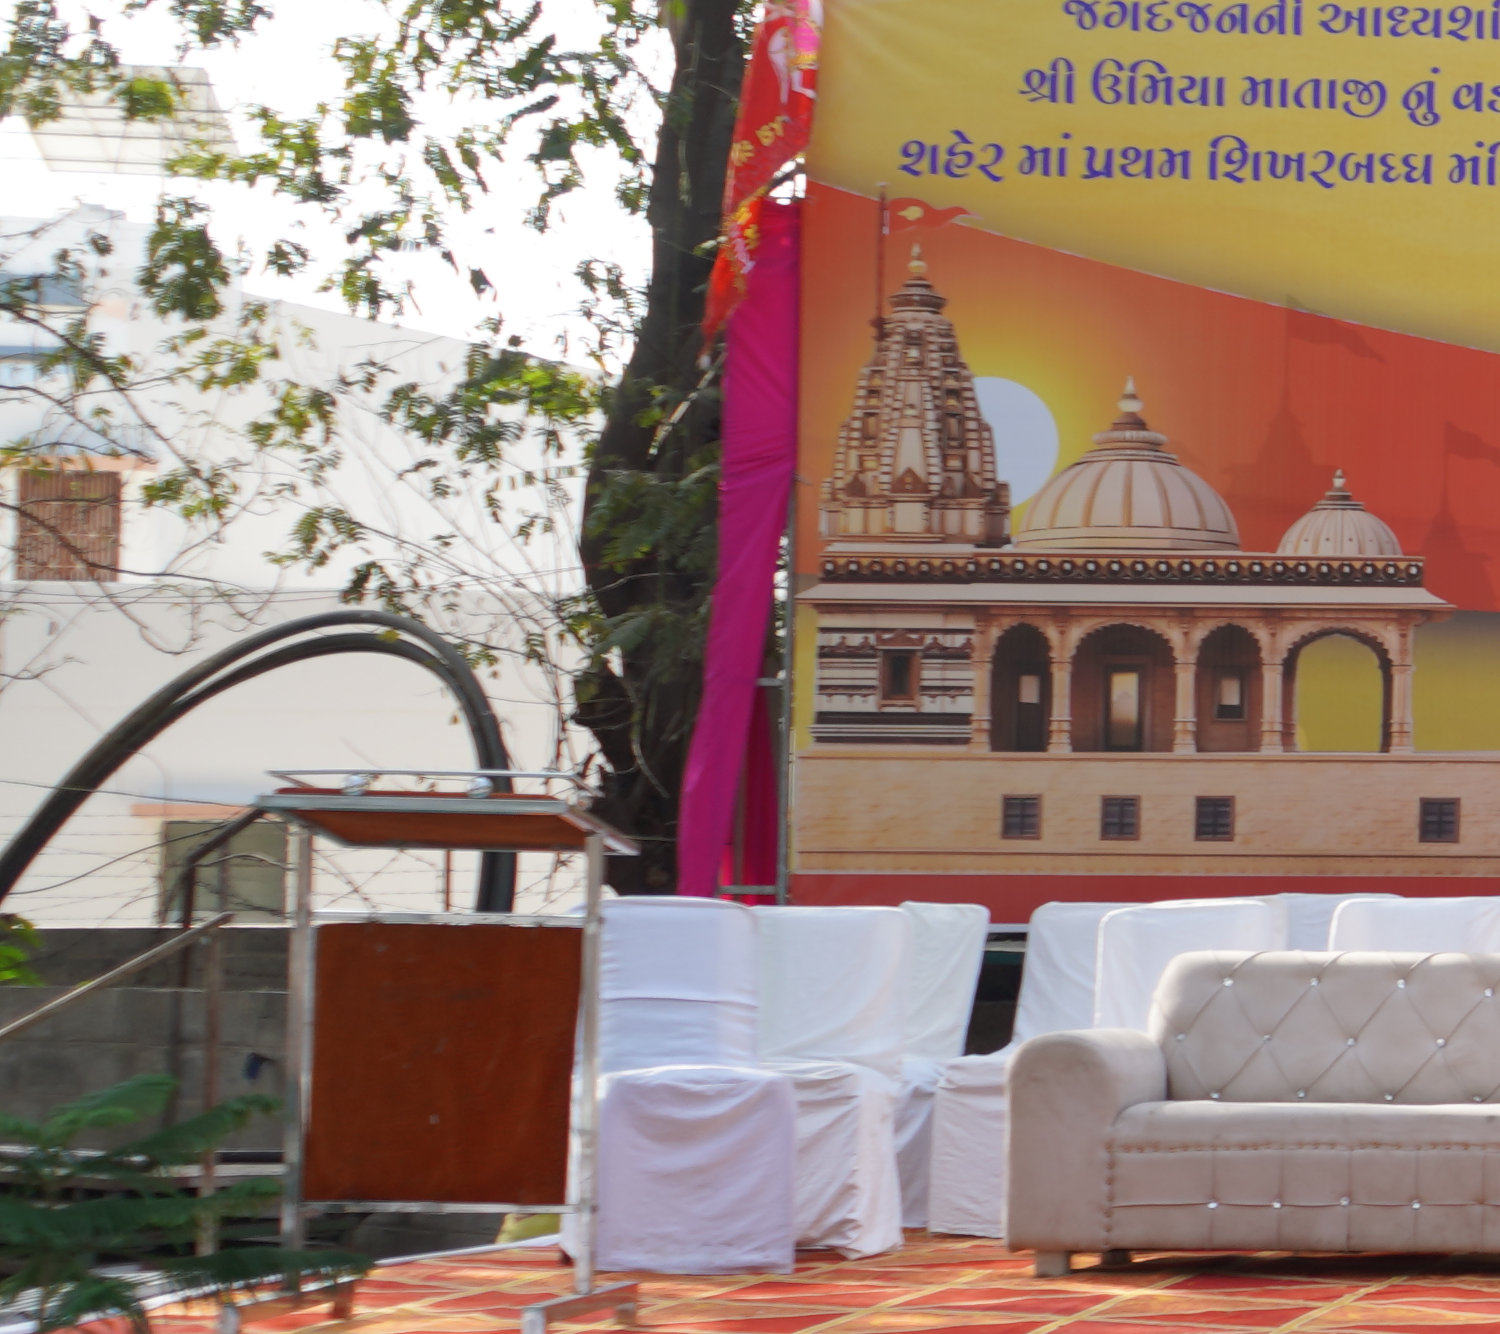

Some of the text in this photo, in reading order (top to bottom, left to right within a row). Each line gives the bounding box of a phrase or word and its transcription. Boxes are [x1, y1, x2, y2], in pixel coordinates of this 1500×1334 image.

[1017, 57, 1075, 105] શ્રી
[1092, 58, 1225, 107] ઉમિયા
[1241, 75, 1388, 118] માતાજી
[1401, 66, 1442, 127] નું
[898, 129, 1005, 183] શહેર
[1018, 132, 1073, 179] માં
[1081, 144, 1191, 181] પ્રથમ
